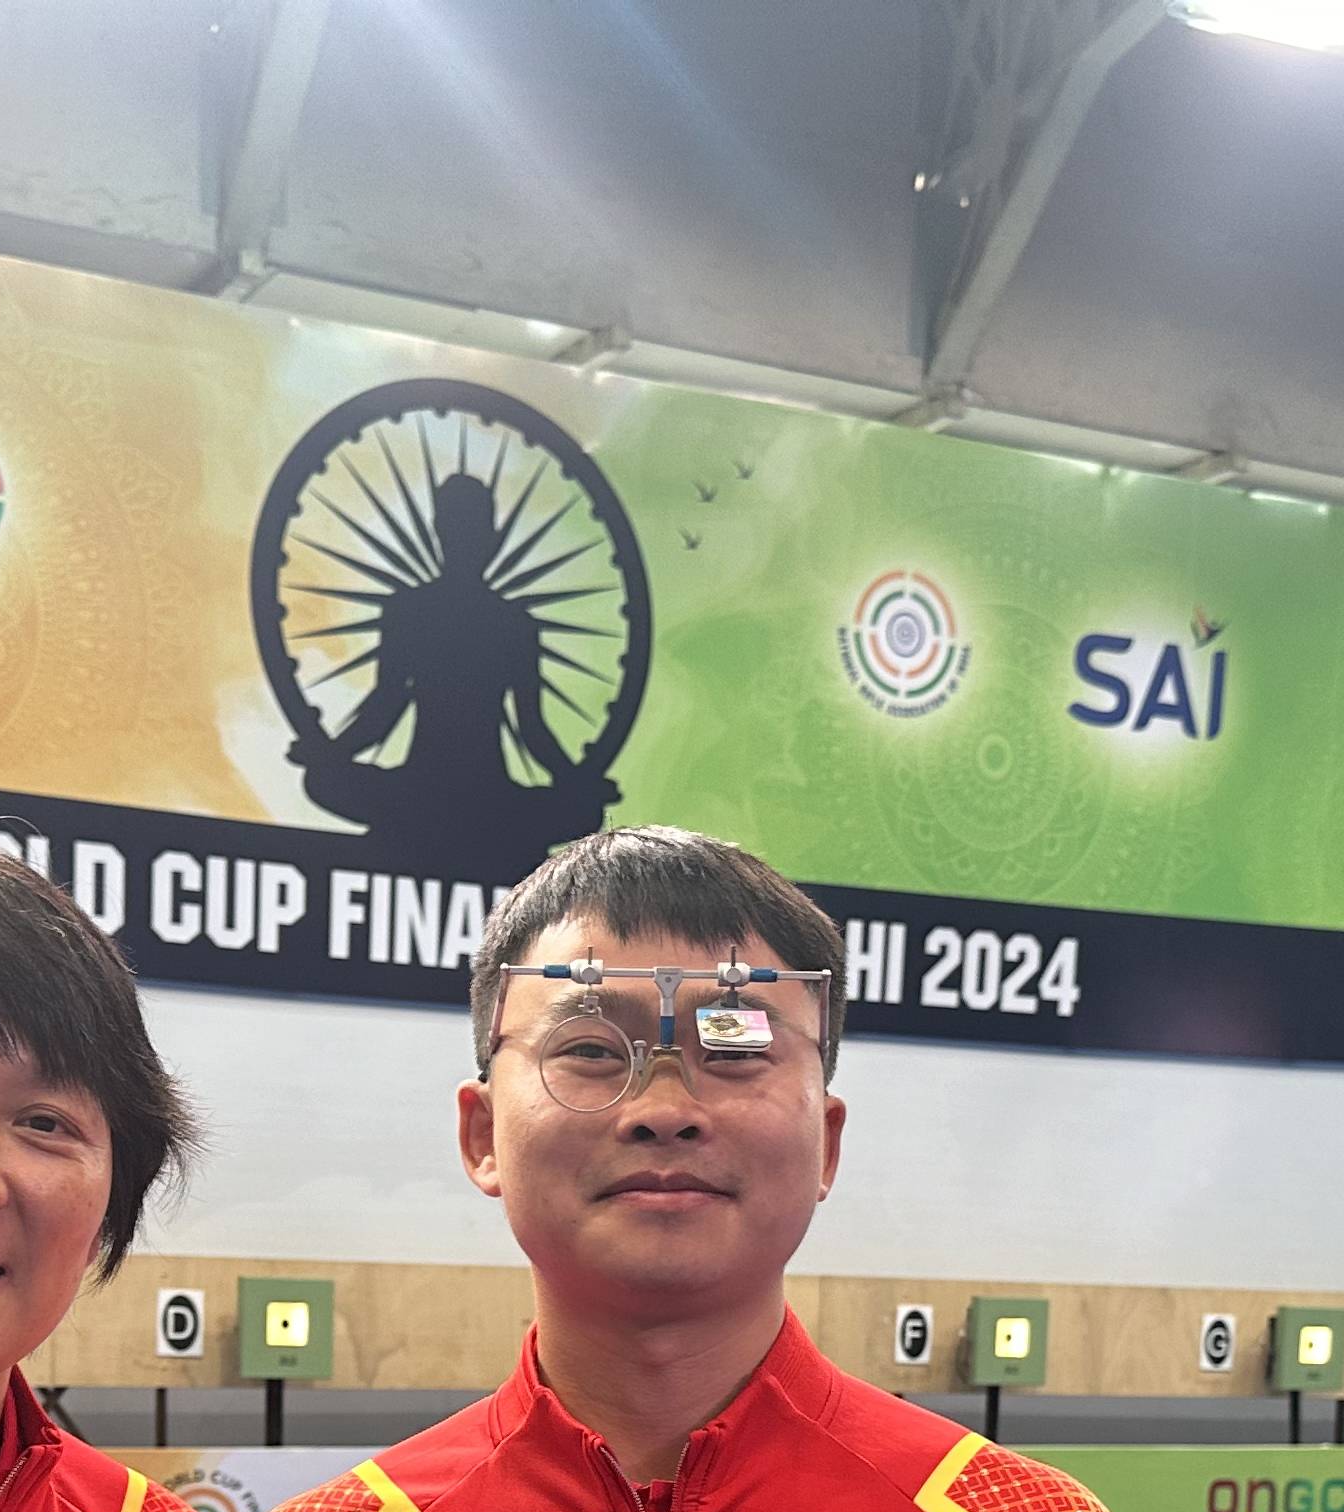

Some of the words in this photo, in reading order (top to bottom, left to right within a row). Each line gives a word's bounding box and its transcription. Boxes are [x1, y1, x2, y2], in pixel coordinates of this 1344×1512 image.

[1067, 633, 1227, 741] SAI
[151, 849, 306, 954] CUP
[328, 868, 511, 971] FINA
[920, 925, 1081, 1017] 2024
[167, 1305, 195, 1340] D
[905, 1318, 922, 1350] F
[1206, 1326, 1229, 1358] G
